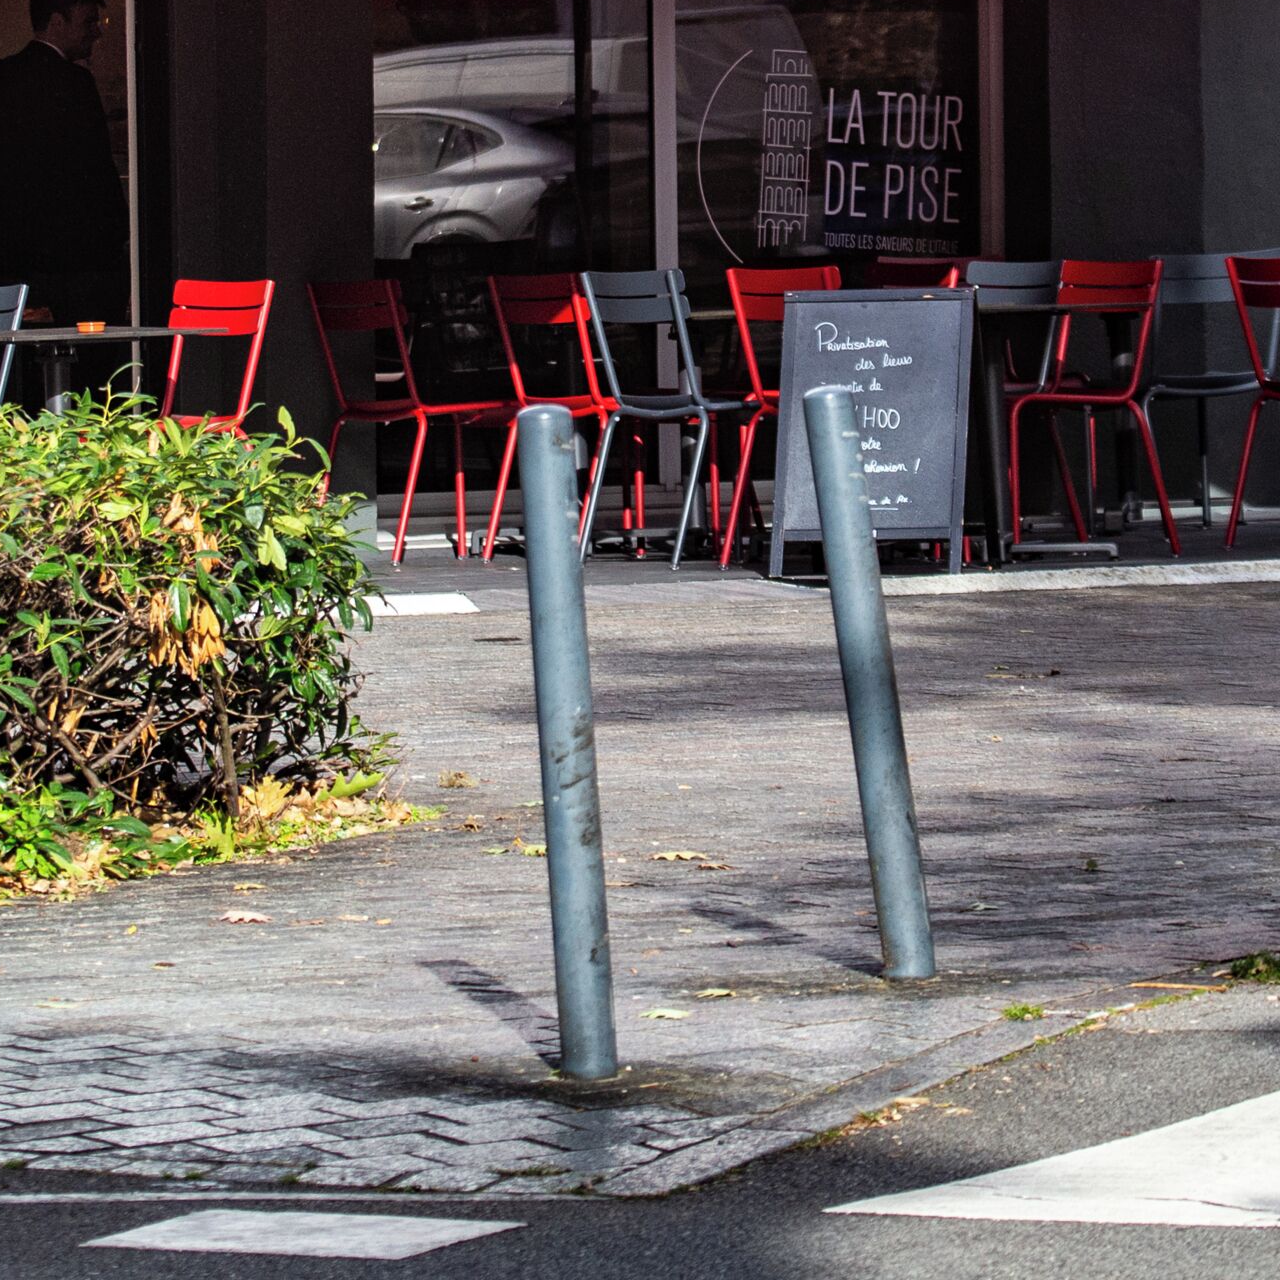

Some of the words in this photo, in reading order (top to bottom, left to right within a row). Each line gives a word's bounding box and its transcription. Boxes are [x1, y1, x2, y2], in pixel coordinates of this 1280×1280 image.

[827, 87, 866, 145] LA
[877, 90, 964, 152] TOUR
[824, 160, 870, 218] DE
[883, 163, 962, 224] PISE
[824, 232, 856, 249] TOUTES
[857, 234, 874, 250] LES
[875, 236, 913, 252] SAVEURS
[915, 239, 926, 253] DE
[855, 358, 876, 371] des
[869, 377, 884, 391] de
[861, 437, 882, 450] otre
